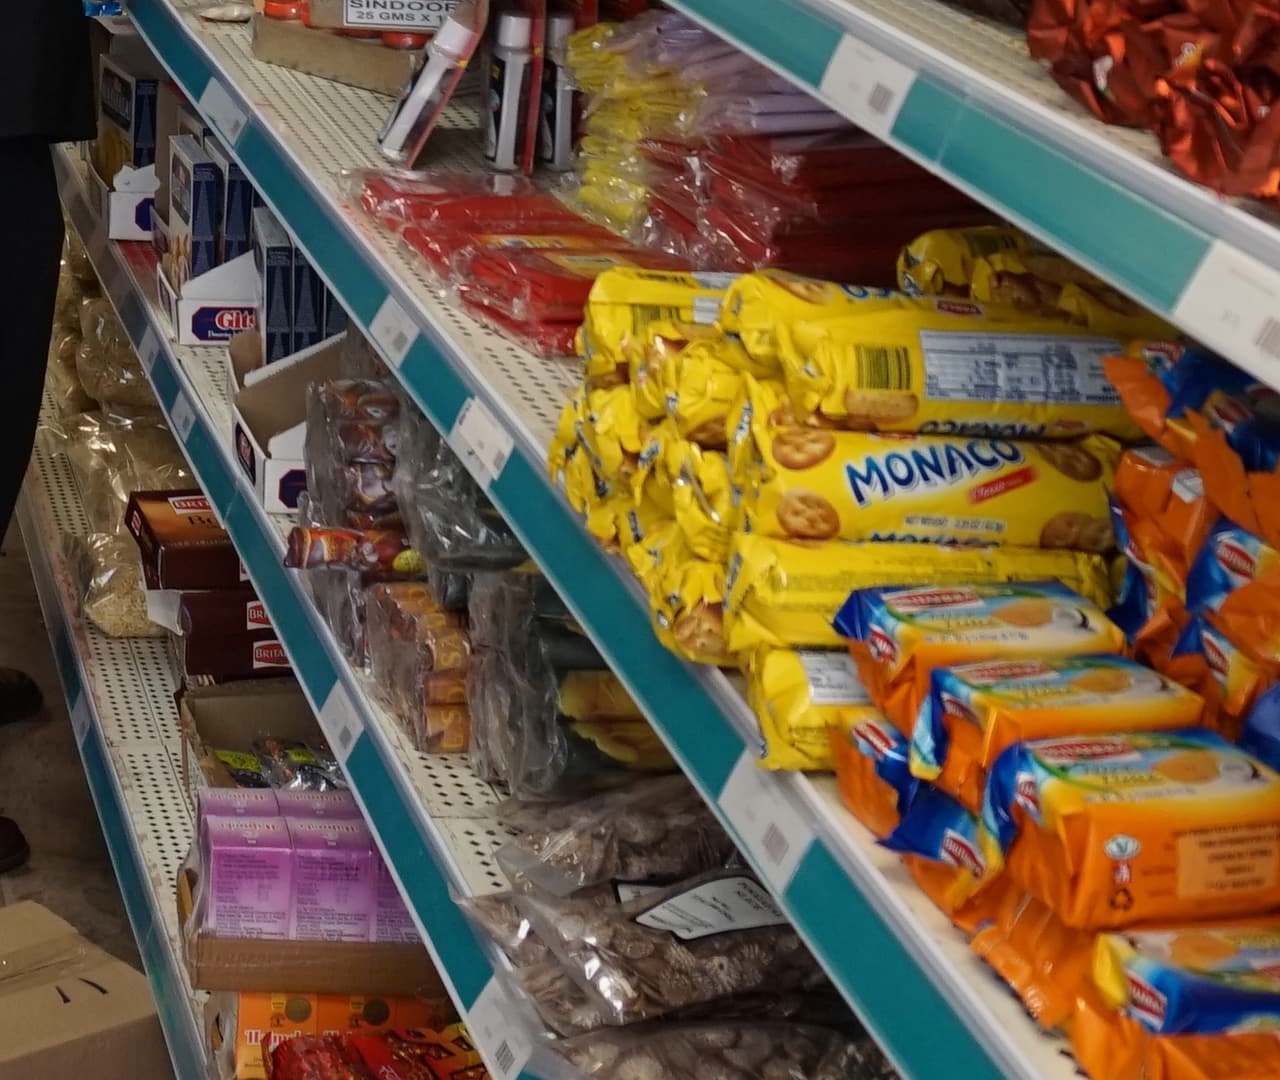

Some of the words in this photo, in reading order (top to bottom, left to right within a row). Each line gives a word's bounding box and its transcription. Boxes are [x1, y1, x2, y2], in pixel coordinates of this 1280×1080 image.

[357, 10, 374, 20] 25
[378, 11, 415, 22] GMS
[844, 438, 1023, 506] MONACO
